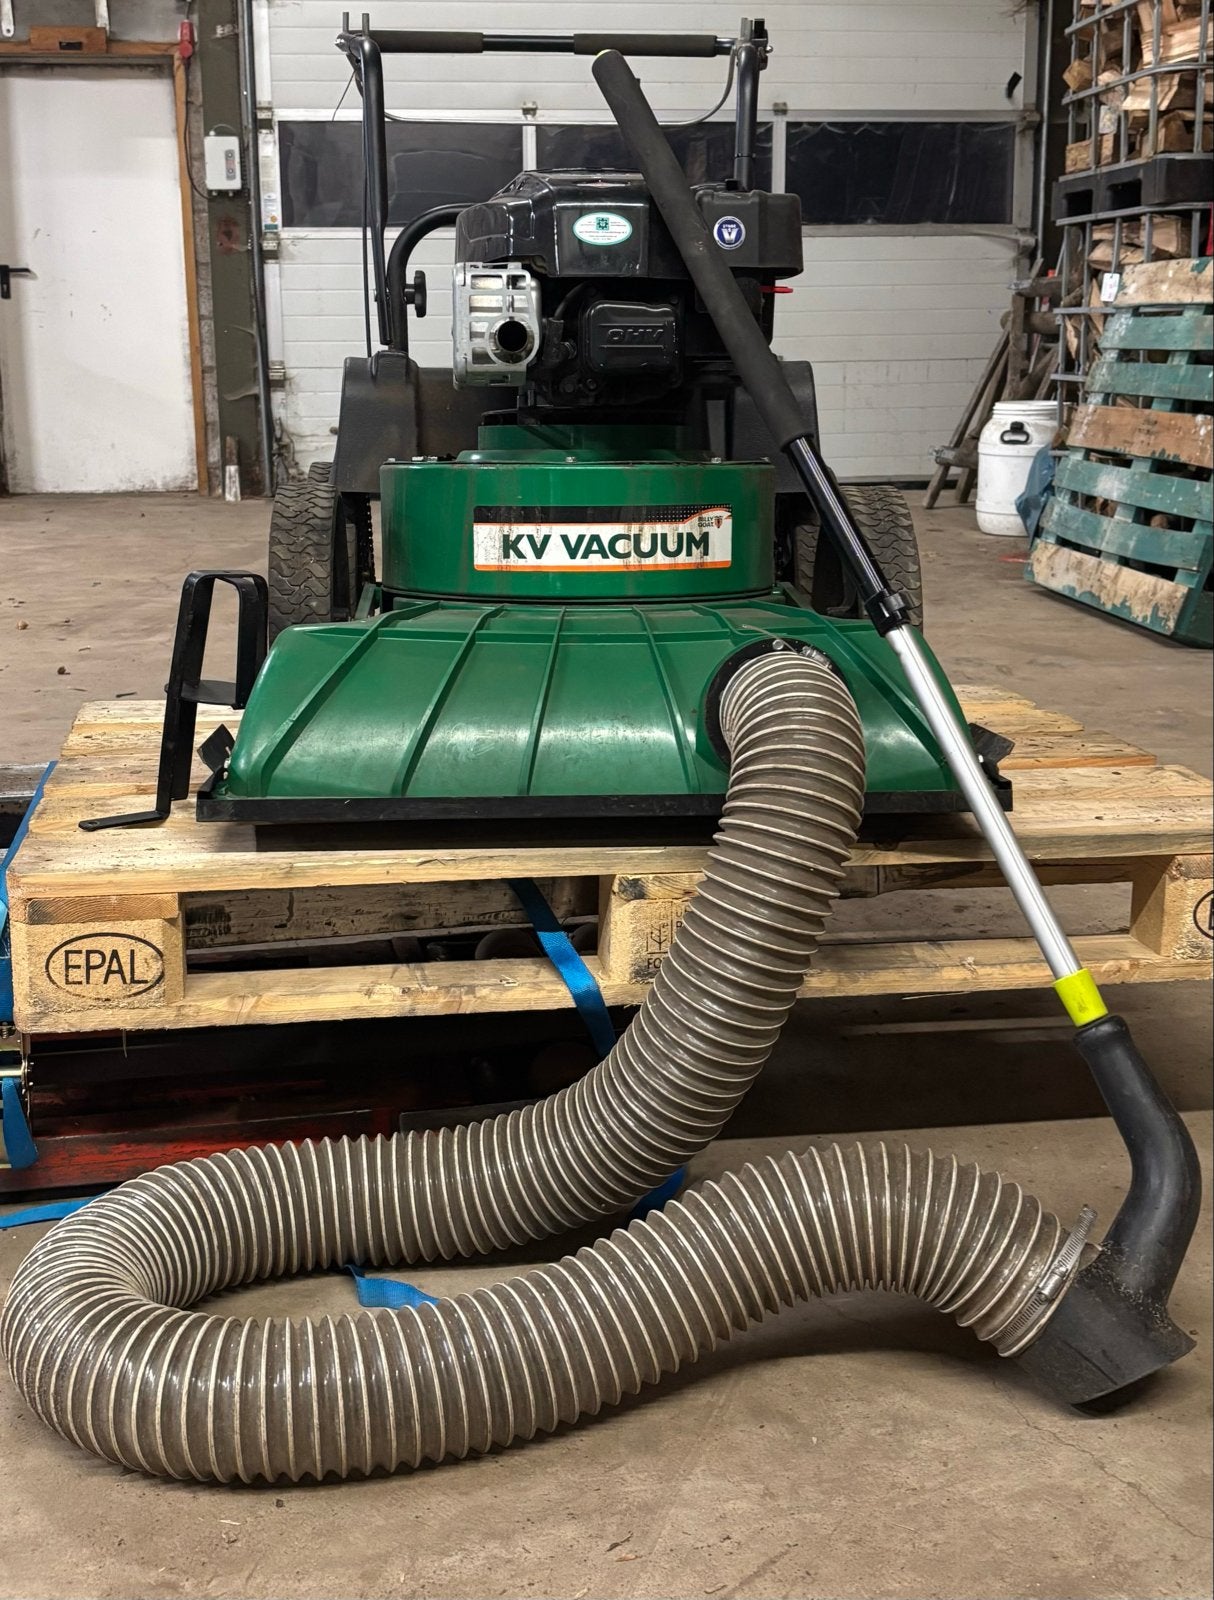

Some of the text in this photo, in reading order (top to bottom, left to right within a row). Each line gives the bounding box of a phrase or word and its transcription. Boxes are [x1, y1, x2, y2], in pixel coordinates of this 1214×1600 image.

[607, 328, 664, 344] OHV
[502, 531, 710, 560] KV VACUUM
[64, 949, 149, 985] EPAL
